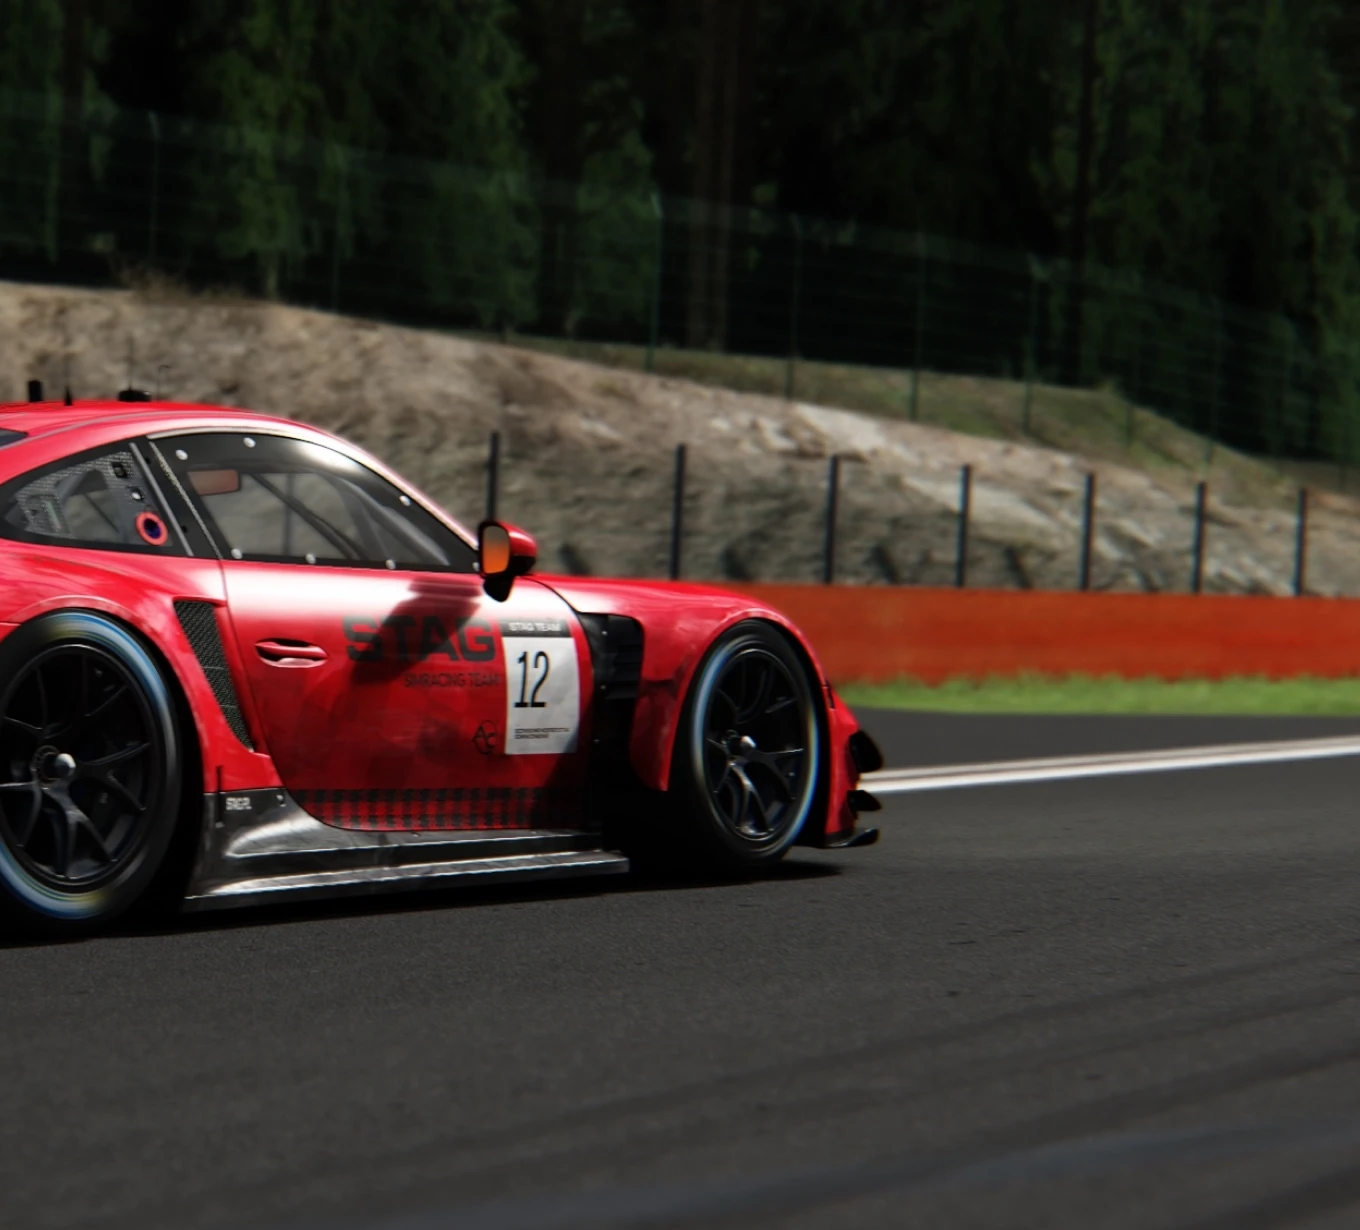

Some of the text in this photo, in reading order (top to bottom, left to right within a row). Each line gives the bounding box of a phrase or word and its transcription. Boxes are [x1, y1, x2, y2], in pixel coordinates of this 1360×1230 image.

[343, 615, 495, 662] STAG
[536, 622, 560, 632] TEAM
[514, 651, 549, 708] 12
